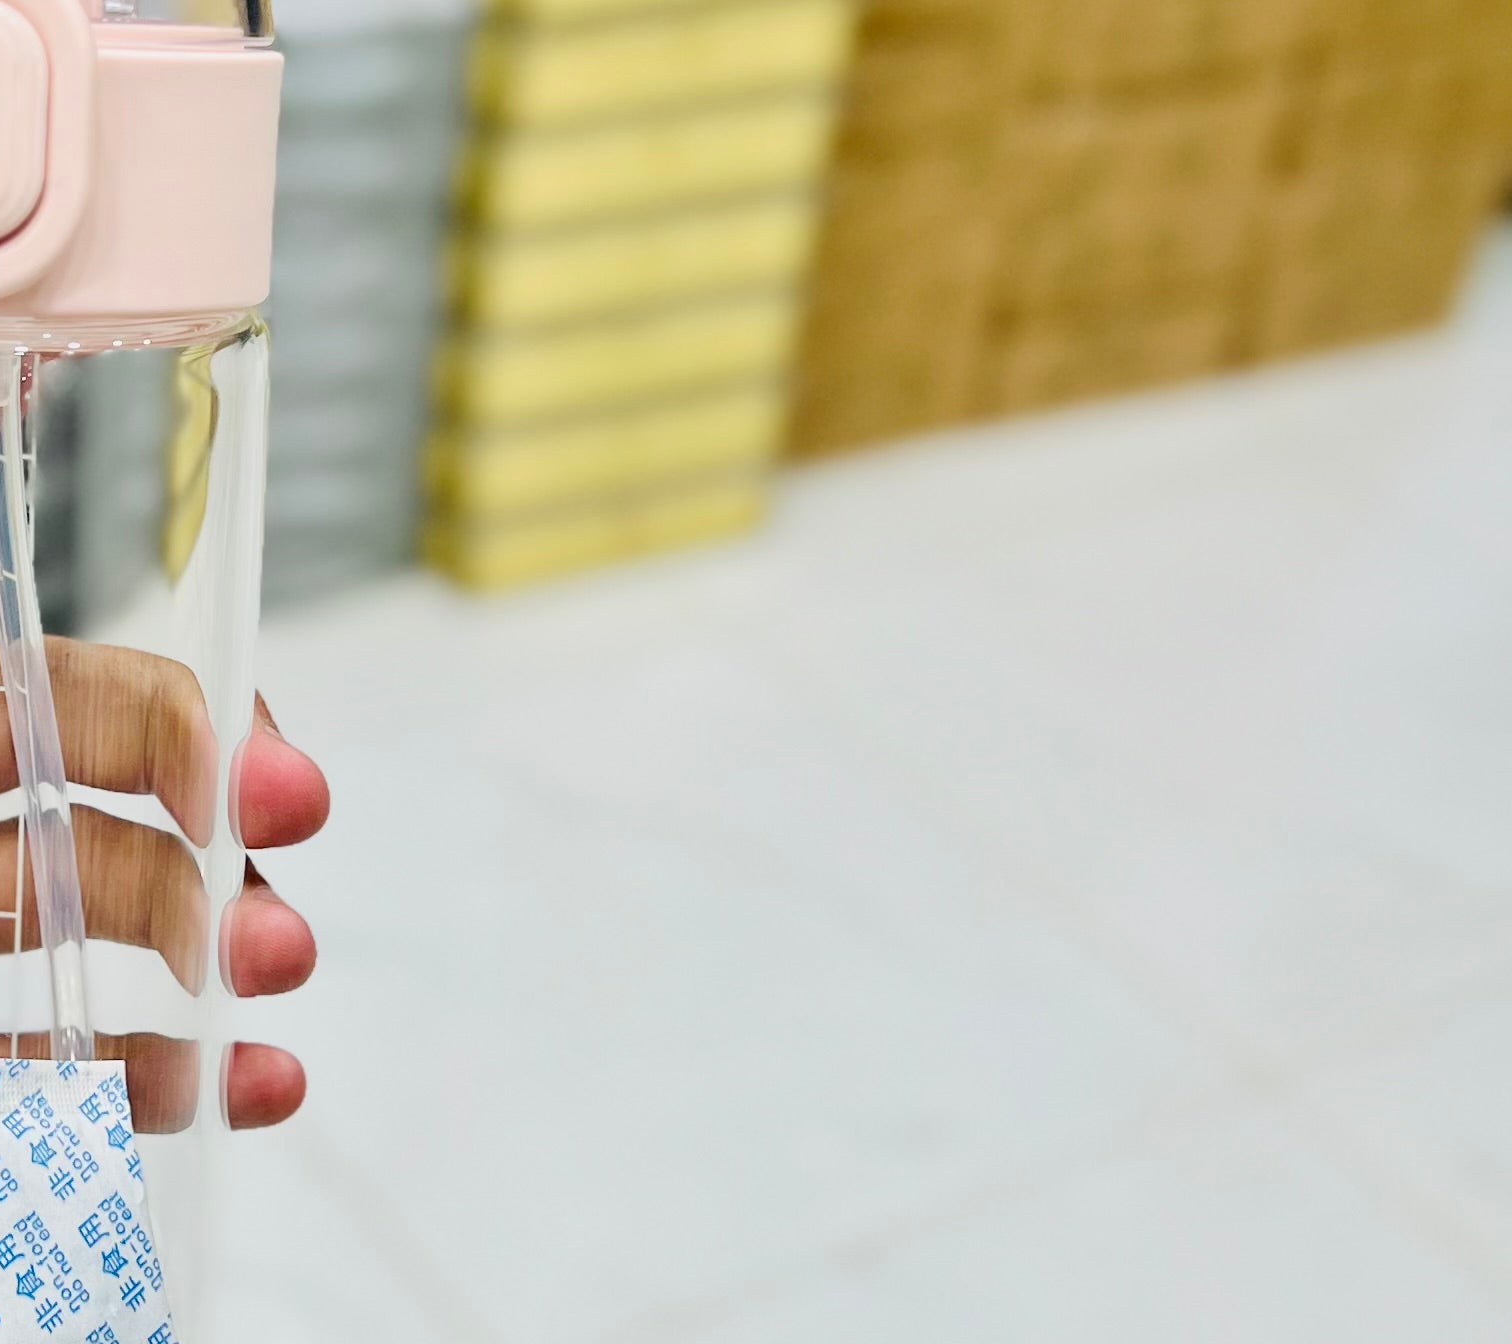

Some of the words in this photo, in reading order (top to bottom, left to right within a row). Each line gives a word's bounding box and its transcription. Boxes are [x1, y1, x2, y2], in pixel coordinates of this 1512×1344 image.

[29, 1088, 53, 1118] eat
[55, 1121, 80, 1147] not
[1, 1108, 76, 1201] 非食用
[82, 1150, 99, 1174] do
[0, 1168, 18, 1192] do
[108, 1191, 132, 1221] eat
[25, 1210, 50, 1241] eat
[131, 1223, 152, 1254] not
[48, 1243, 72, 1276] not
[77, 1212, 146, 1312] 非食用
[72, 1278, 90, 1303] do
